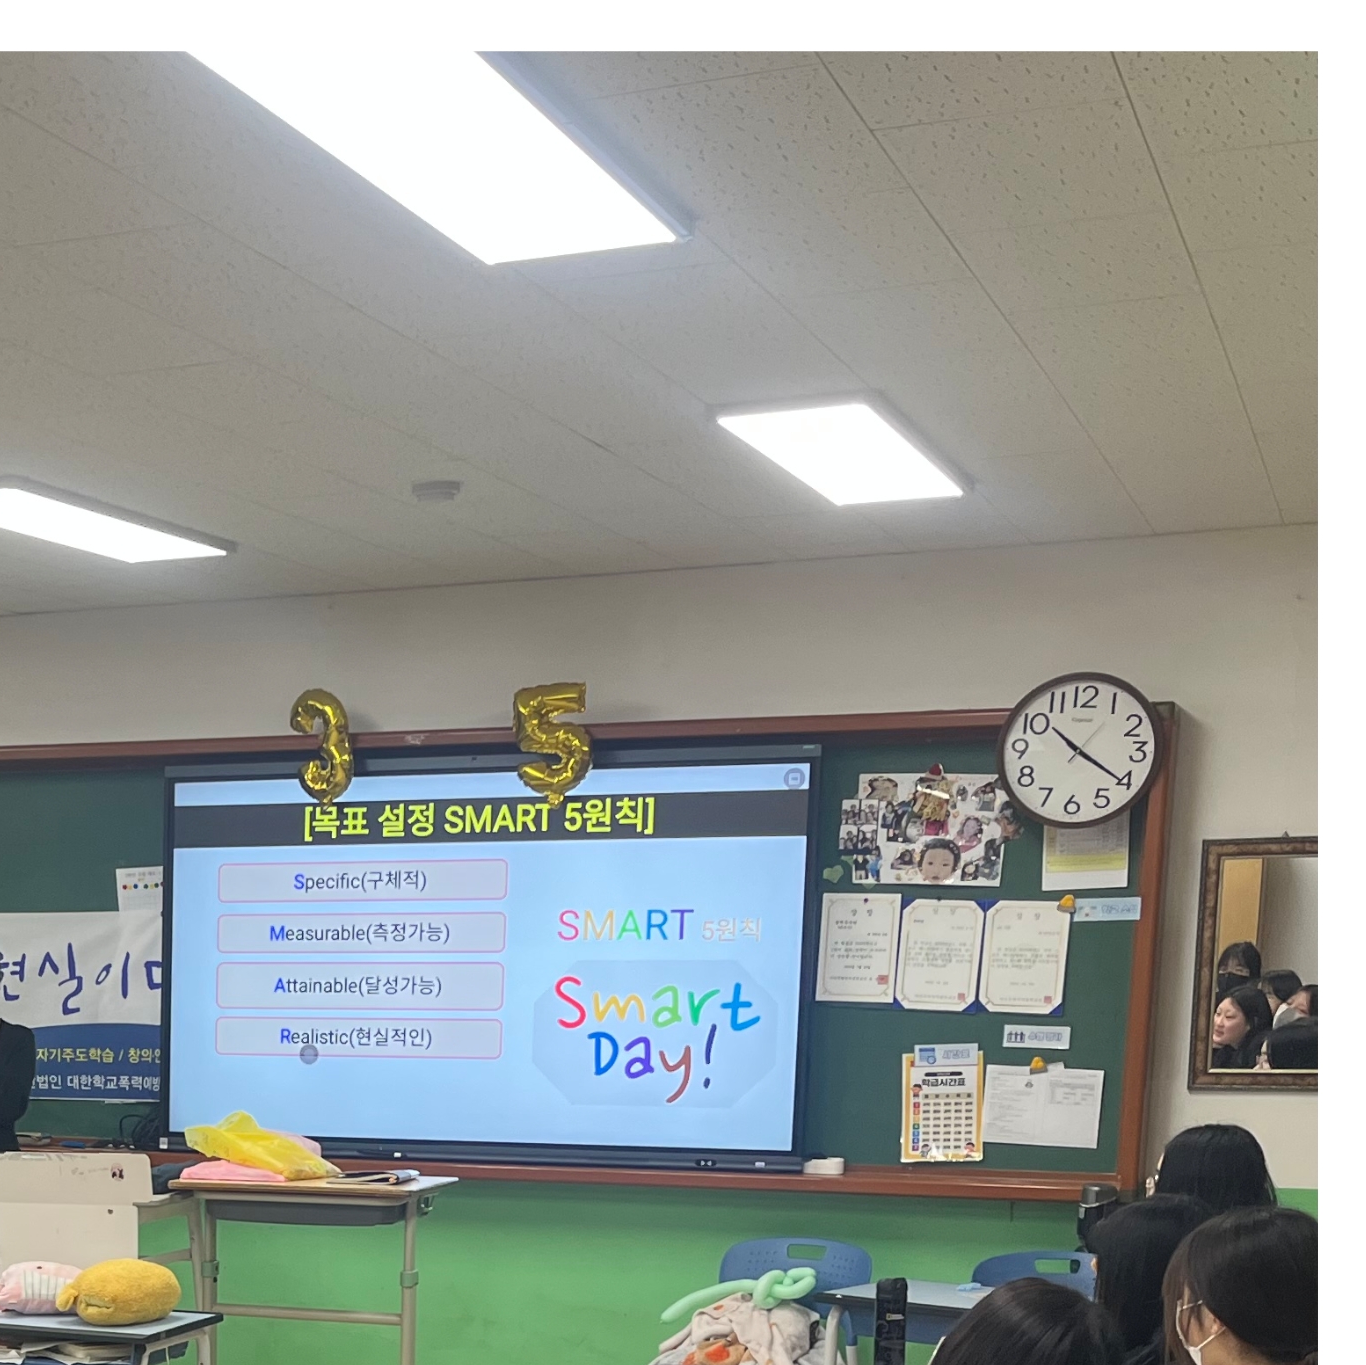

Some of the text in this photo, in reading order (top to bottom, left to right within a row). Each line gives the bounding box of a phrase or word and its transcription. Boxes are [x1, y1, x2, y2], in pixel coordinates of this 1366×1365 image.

[1049, 692, 1065, 713] 11
[1073, 685, 1099, 708] 12
[1111, 692, 1117, 714] 1
[1023, 713, 1050, 735] 10
[1124, 714, 1142, 737] 2
[291, 688, 353, 807] 3
[513, 681, 593, 807] 5
[1012, 738, 1028, 759] 9
[1129, 741, 1148, 762] 3
[1018, 765, 1034, 787] 8
[1115, 770, 1132, 790] 4
[1039, 787, 1053, 807] 7
[1064, 795, 1081, 814] 6
[1093, 788, 1110, 808] 5
[304, 797, 654, 841] [목표 설정 SMART 5원칙]
[294, 868, 427, 892] Specific(구체적)
[269, 920, 450, 946] Measurable(측정가능)
[557, 909, 760, 942] SMART 5원칙
[273, 975, 442, 999] Attainable(달성가능)
[554, 975, 760, 1031] Smart
[280, 1026, 432, 1049] Realistic(현실적인)
[36, 1049, 114, 1063] 자기주도학습
[587, 1024, 717, 1103] Day!
[31, 1075, 61, 1090] 법인
[922, 1078, 965, 1087] 학급시간표
